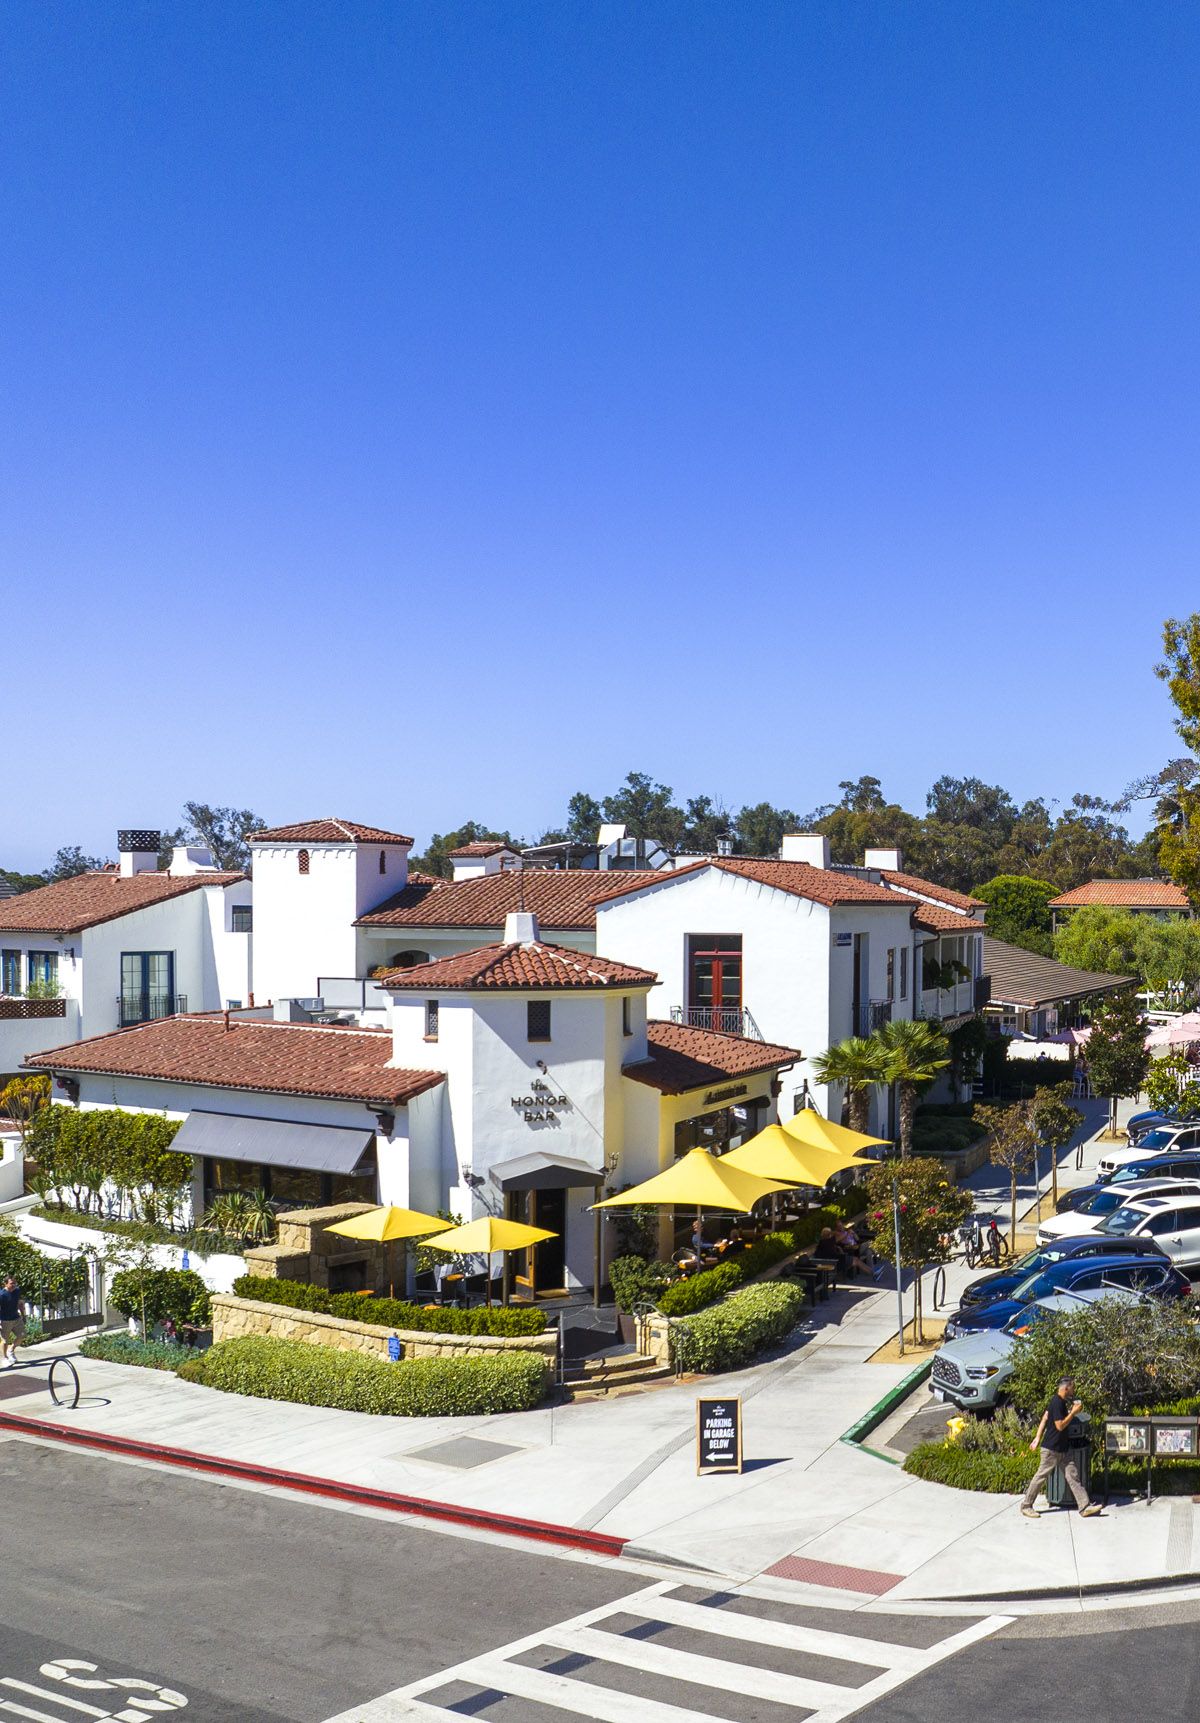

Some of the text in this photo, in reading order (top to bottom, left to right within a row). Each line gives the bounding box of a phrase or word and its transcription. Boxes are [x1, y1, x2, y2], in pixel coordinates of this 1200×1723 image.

[511, 1095, 568, 1107] HONOR
[524, 1110, 555, 1122] BAR
[705, 1418, 732, 1428] PARKING
[703, 1428, 735, 1439] IN GARAGE
[709, 1439, 730, 1449] BELOW
